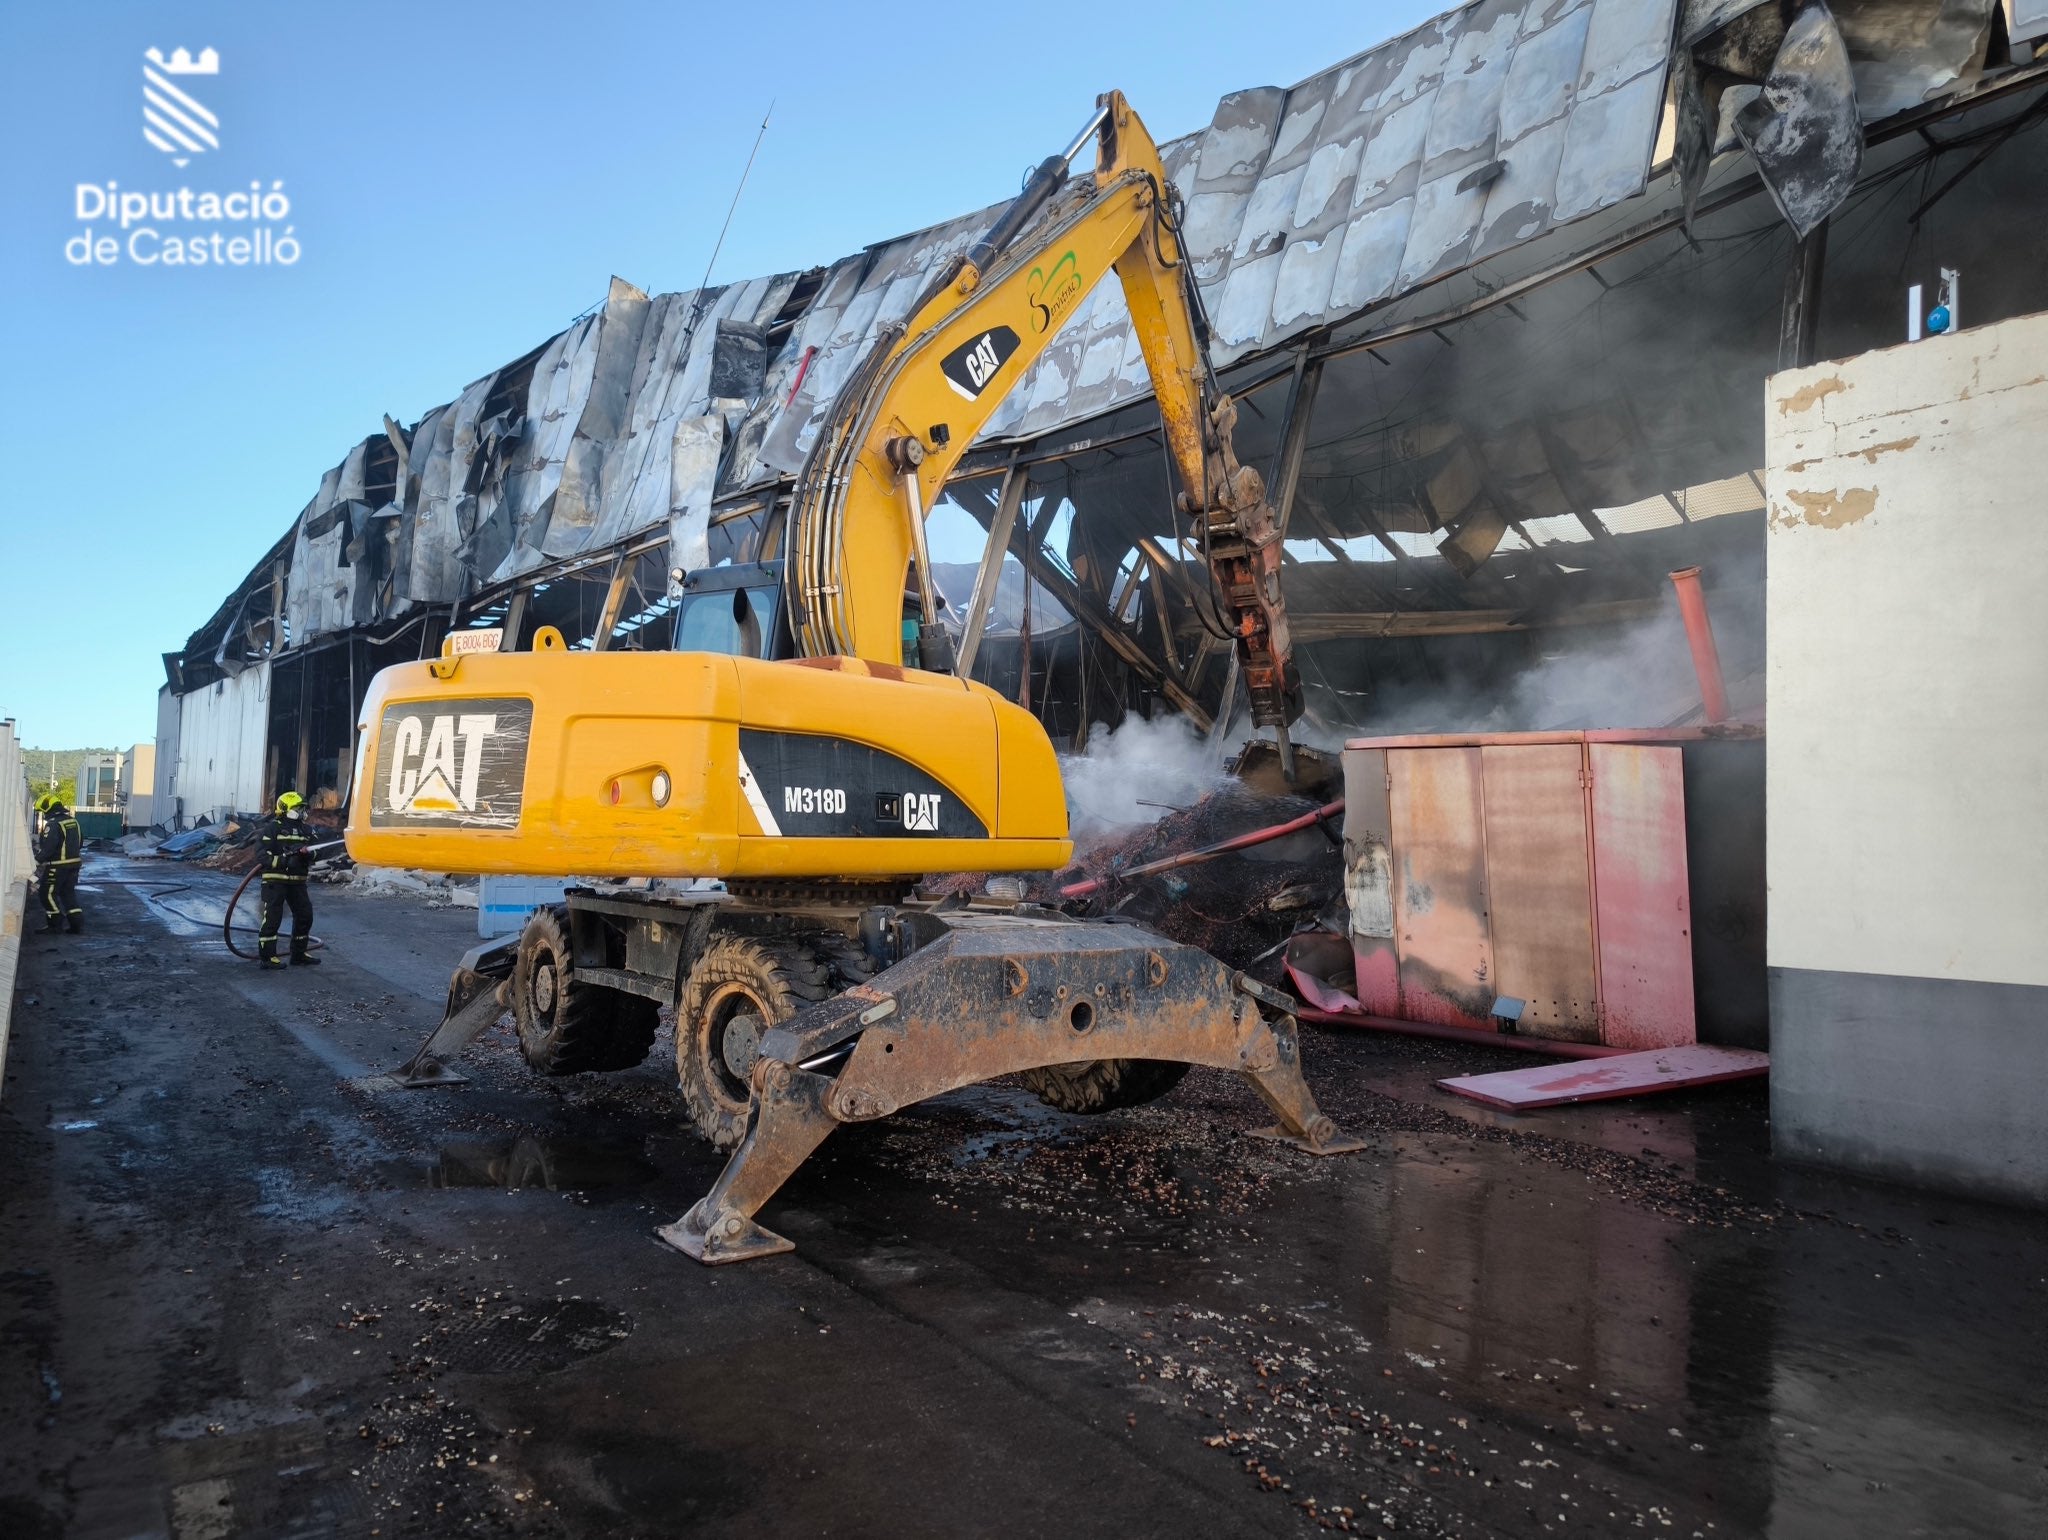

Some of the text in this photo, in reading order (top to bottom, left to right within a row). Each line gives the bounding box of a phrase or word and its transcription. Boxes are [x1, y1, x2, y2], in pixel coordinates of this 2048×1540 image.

[966, 333, 1000, 388] CAT
[389, 714, 497, 813] CAT
[785, 786, 846, 814] M318D
[903, 792, 942, 831] CAT
